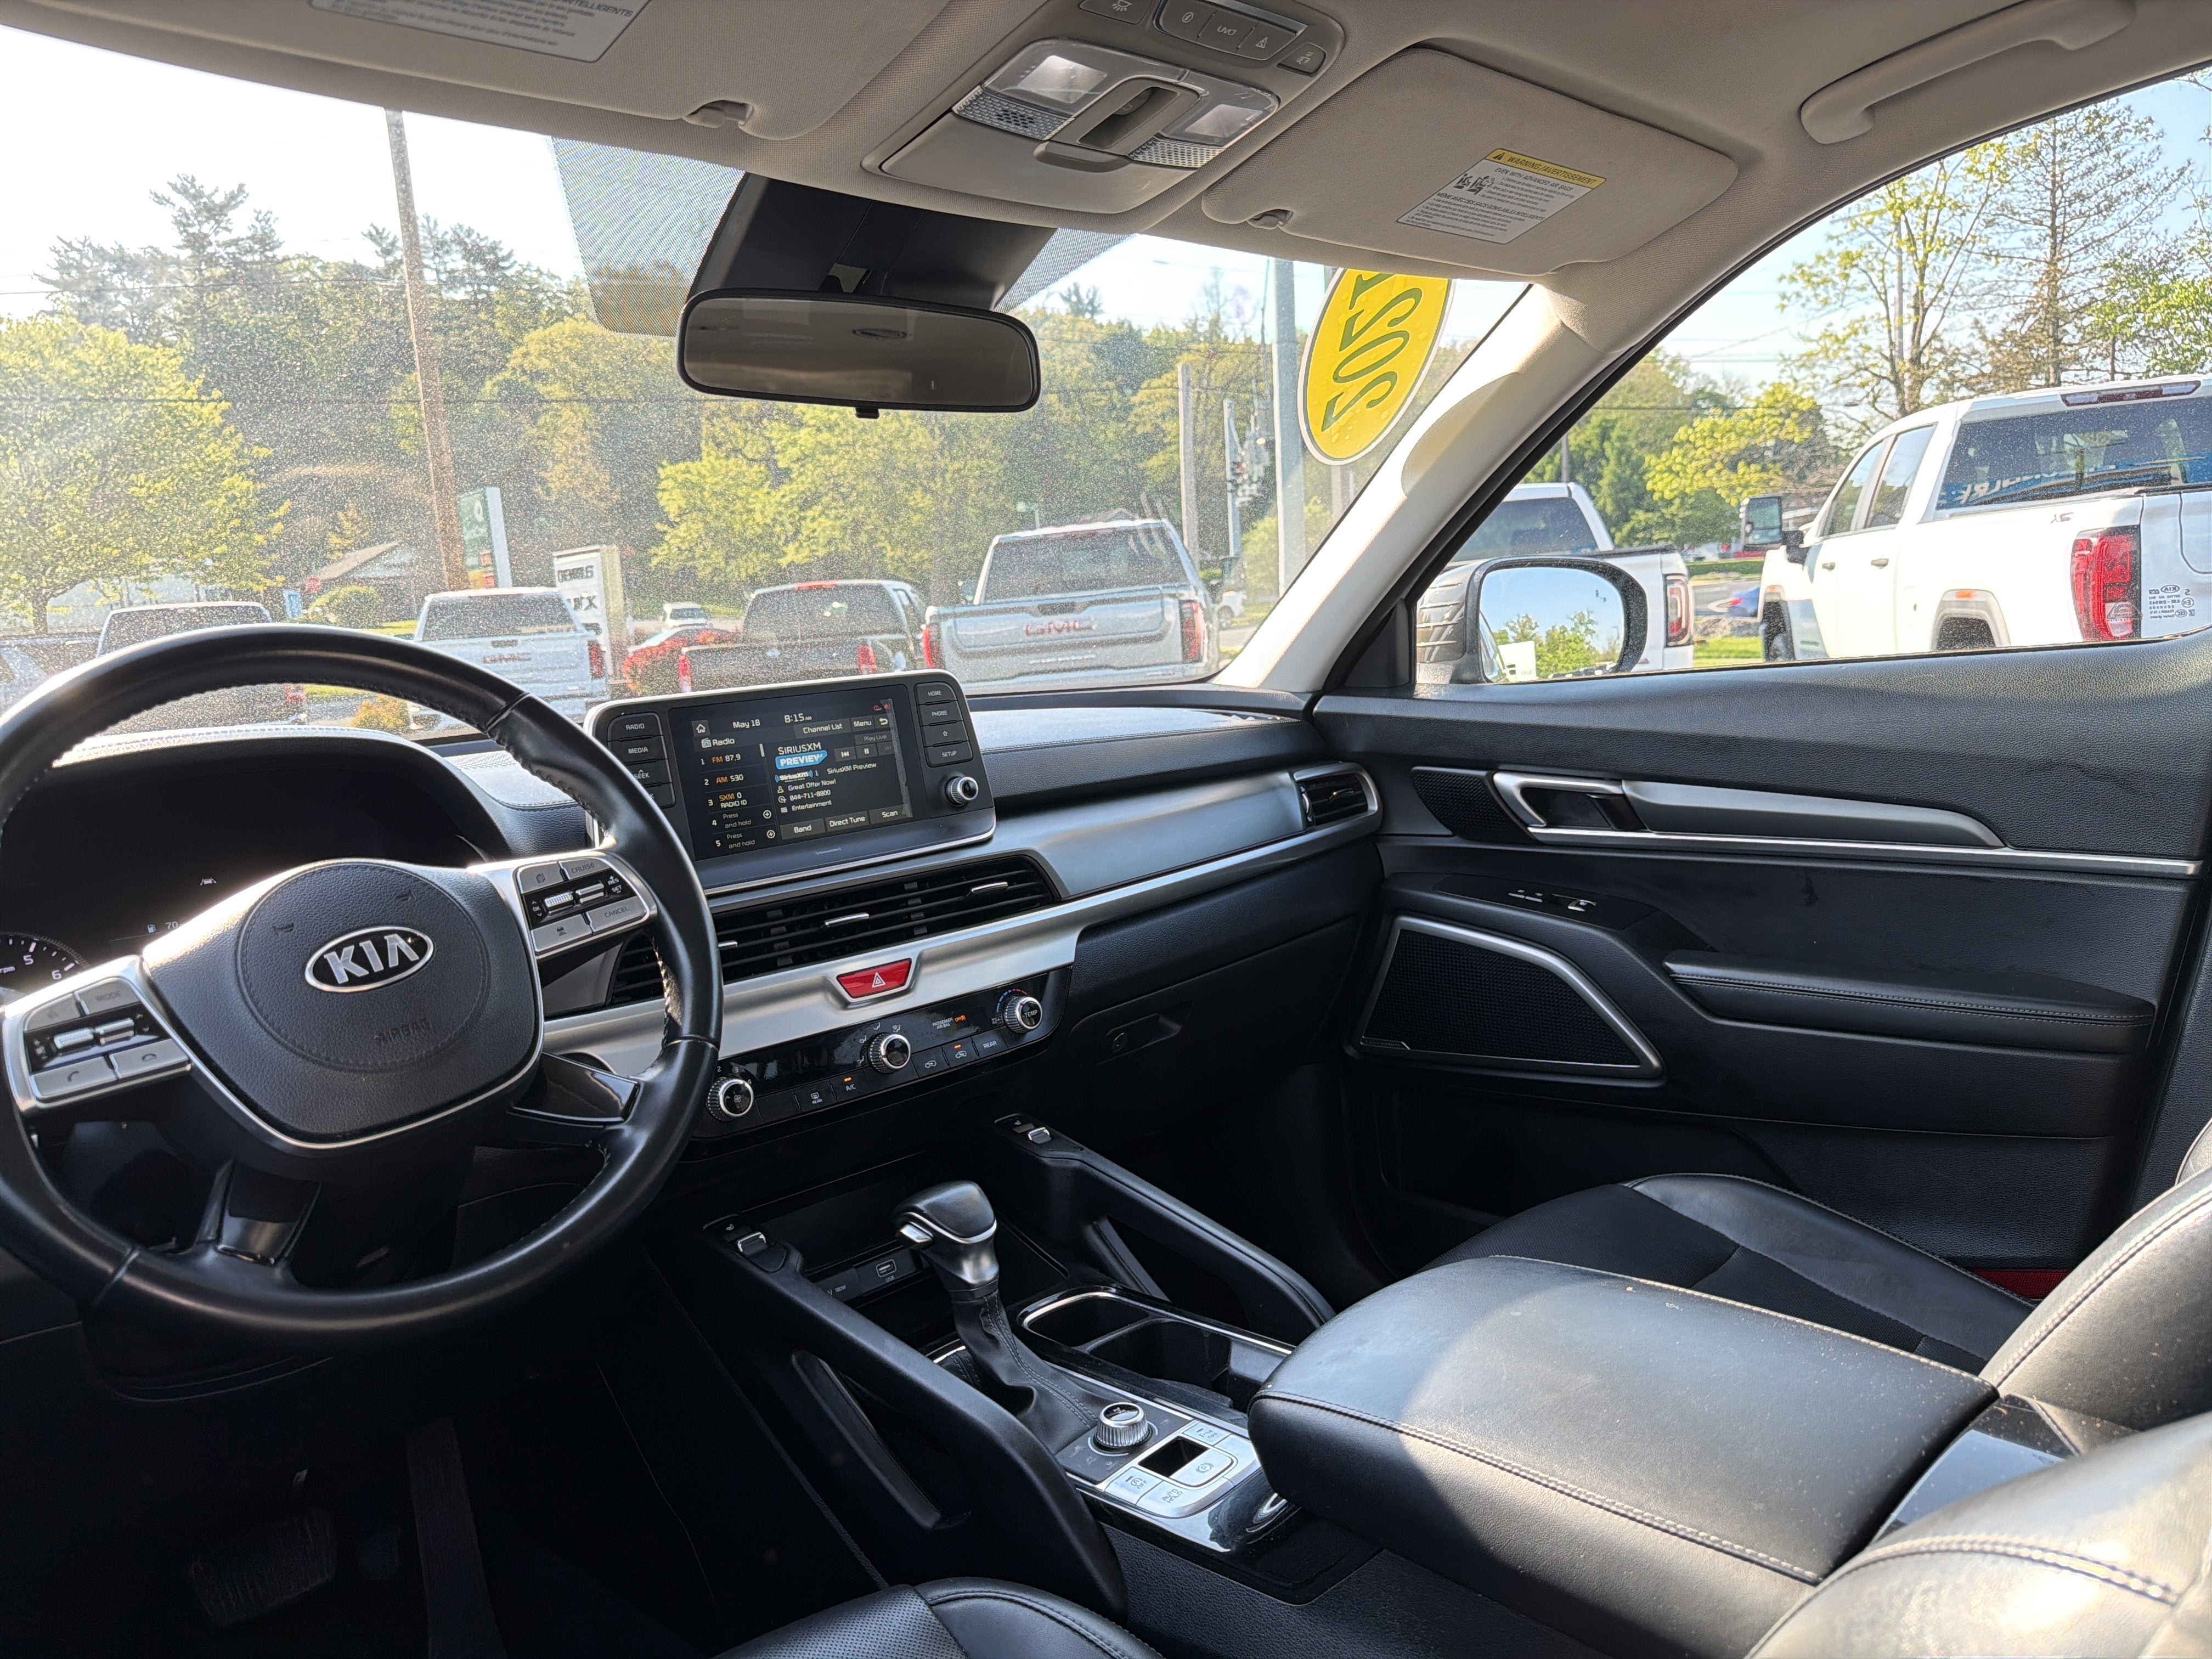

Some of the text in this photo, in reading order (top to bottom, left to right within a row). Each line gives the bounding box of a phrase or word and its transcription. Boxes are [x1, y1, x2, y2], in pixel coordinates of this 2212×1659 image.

[1024, 617, 1095, 636] GMC
[784, 713, 805, 723] 8:15
[803, 724, 831, 734] Channel
[713, 738, 735, 747] Radio
[864, 735, 876, 743] Play
[778, 742, 822, 755] SIRIUSXM
[712, 755, 723, 764] FM
[725, 754, 741, 762] 87.9
[780, 753, 823, 767] PREVIEW
[827, 763, 877, 775] SiriusXM Preview
[730, 774, 743, 782] 530
[788, 783, 805, 791] Great
[806, 781, 820, 789] Offer
[719, 793, 735, 802] SXM
[789, 789, 831, 802] 844-711-8800
[720, 800, 740, 809] RADIO
[792, 800, 832, 811] Entertainment
[882, 810, 899, 818] Scan
[830, 818, 849, 827] Direct
[794, 824, 812, 833] Band
[571, 862, 595, 874] CRUISE
[604, 906, 630, 918] CANCEL
[165, 921, 178, 929] 70
[23, 955, 34, 965] 5
[324, 933, 419, 984] KIA
[52, 969, 62, 980] 6
[95, 989, 122, 1003] MODE
[932, 1017, 953, 1027] PASSENGER
[983, 1040, 997, 1049] REAR
[846, 1084, 856, 1092] A/C
[1162, 1488, 1178, 1501] AUTO
